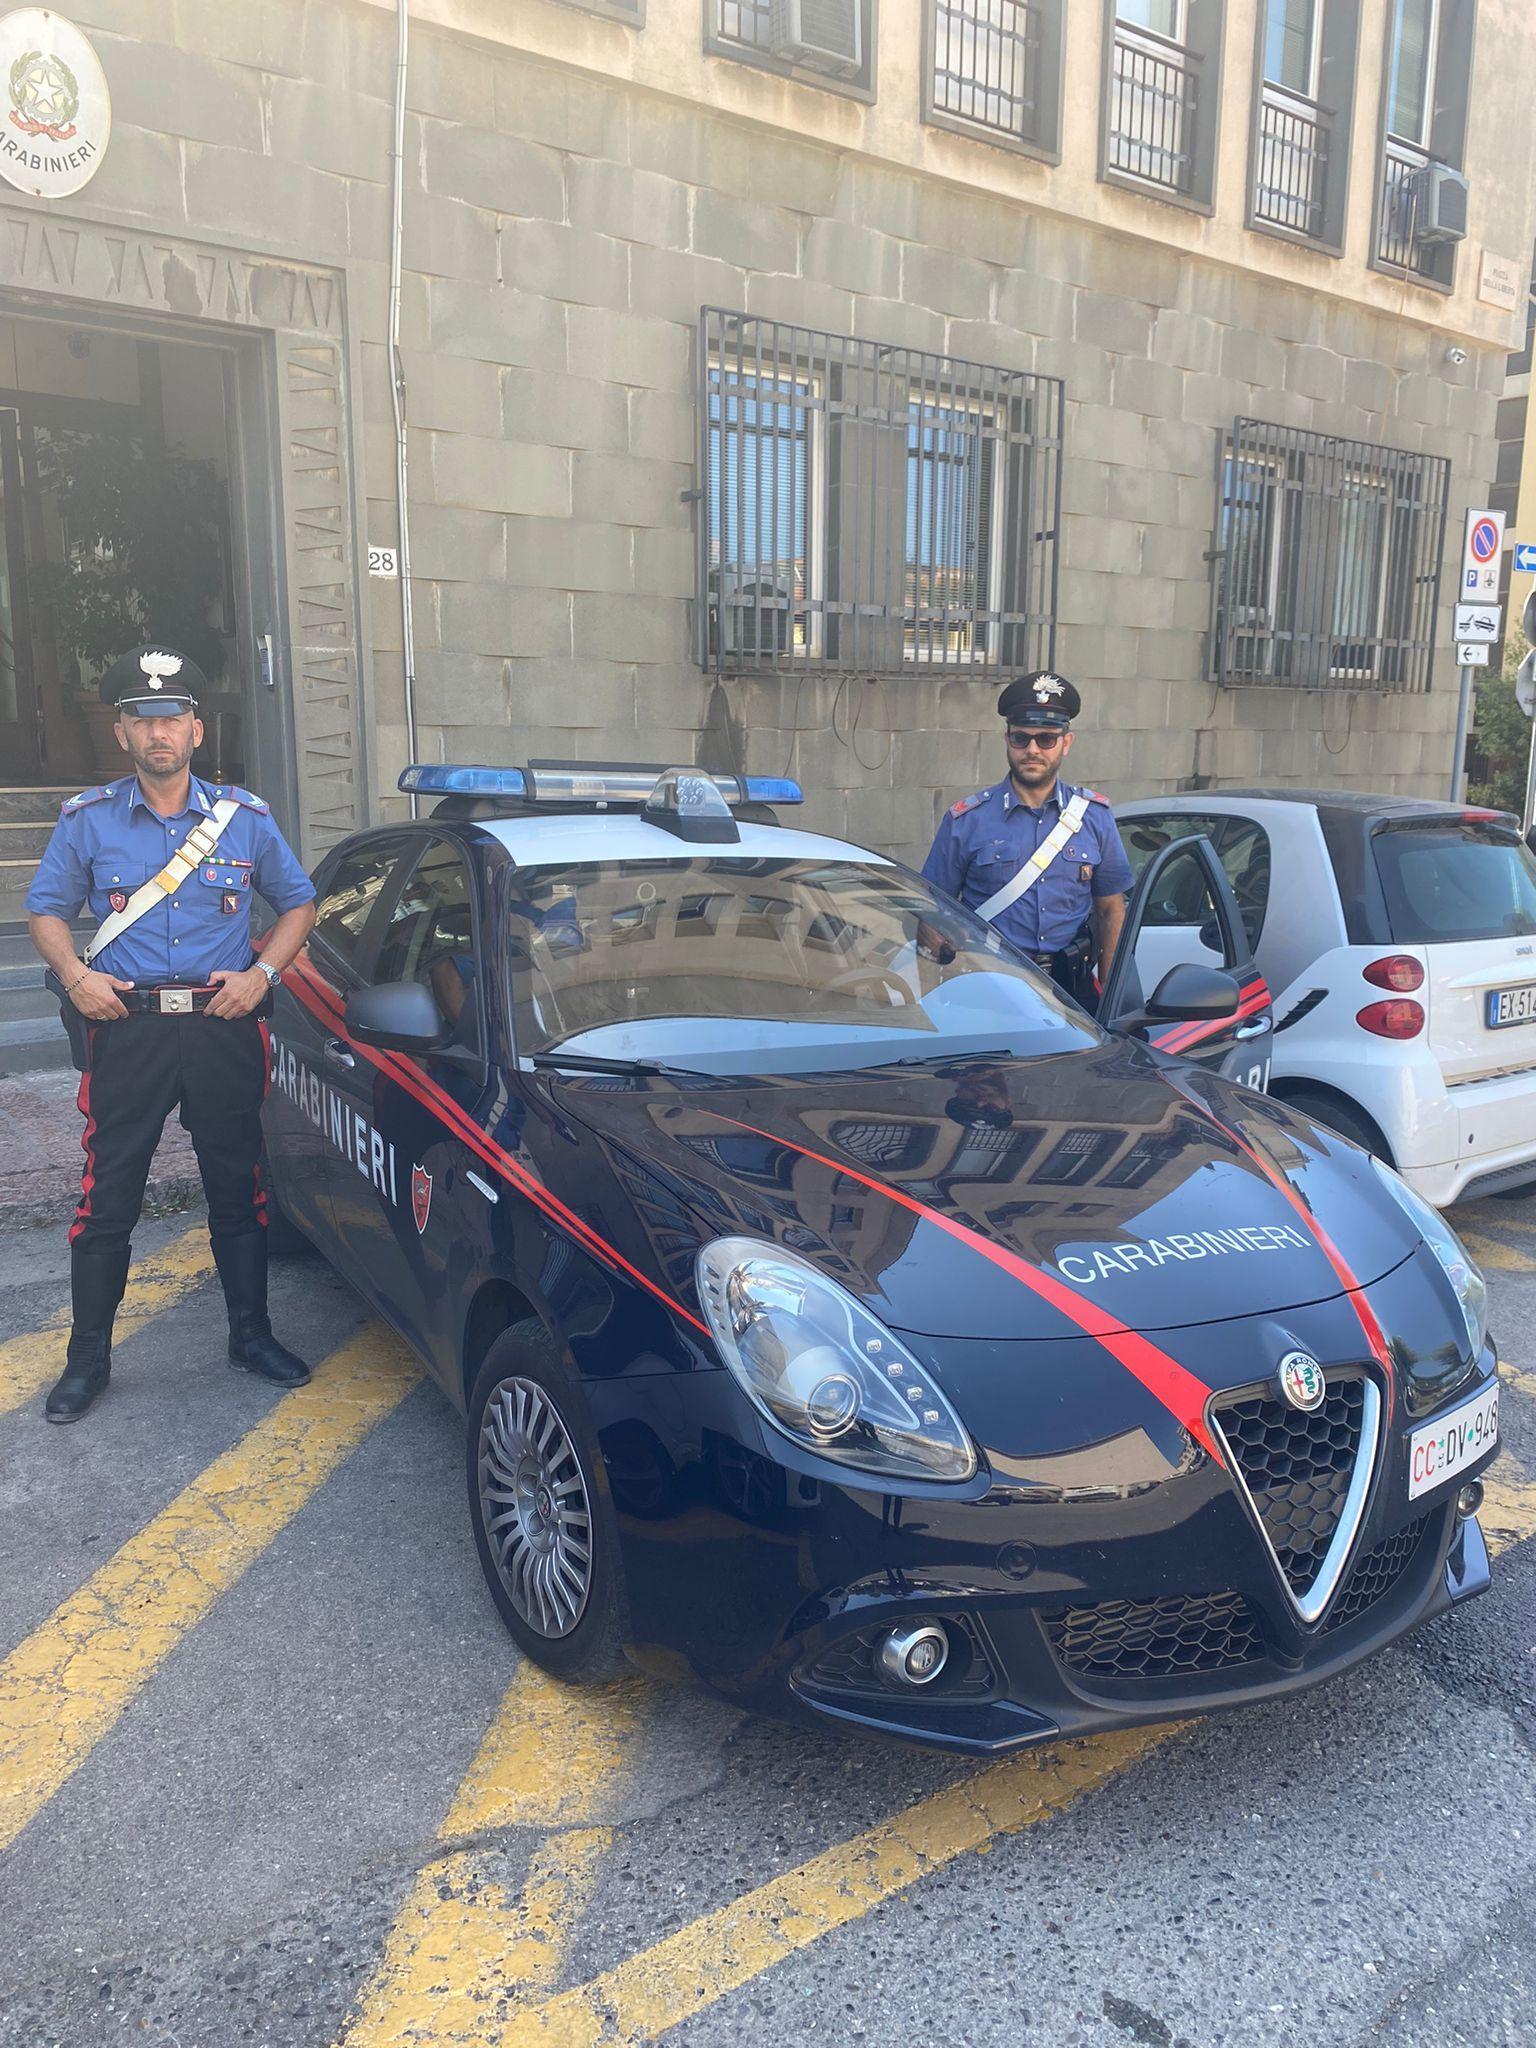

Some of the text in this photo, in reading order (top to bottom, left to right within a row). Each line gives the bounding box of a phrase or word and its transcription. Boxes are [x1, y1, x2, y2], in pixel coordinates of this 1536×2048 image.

[369, 552, 393, 571] 28
[269, 1033, 398, 1207] CARABINIERI
[1057, 1225, 1312, 1284] CARABINIERI
[1413, 1440, 1436, 1482] CC
